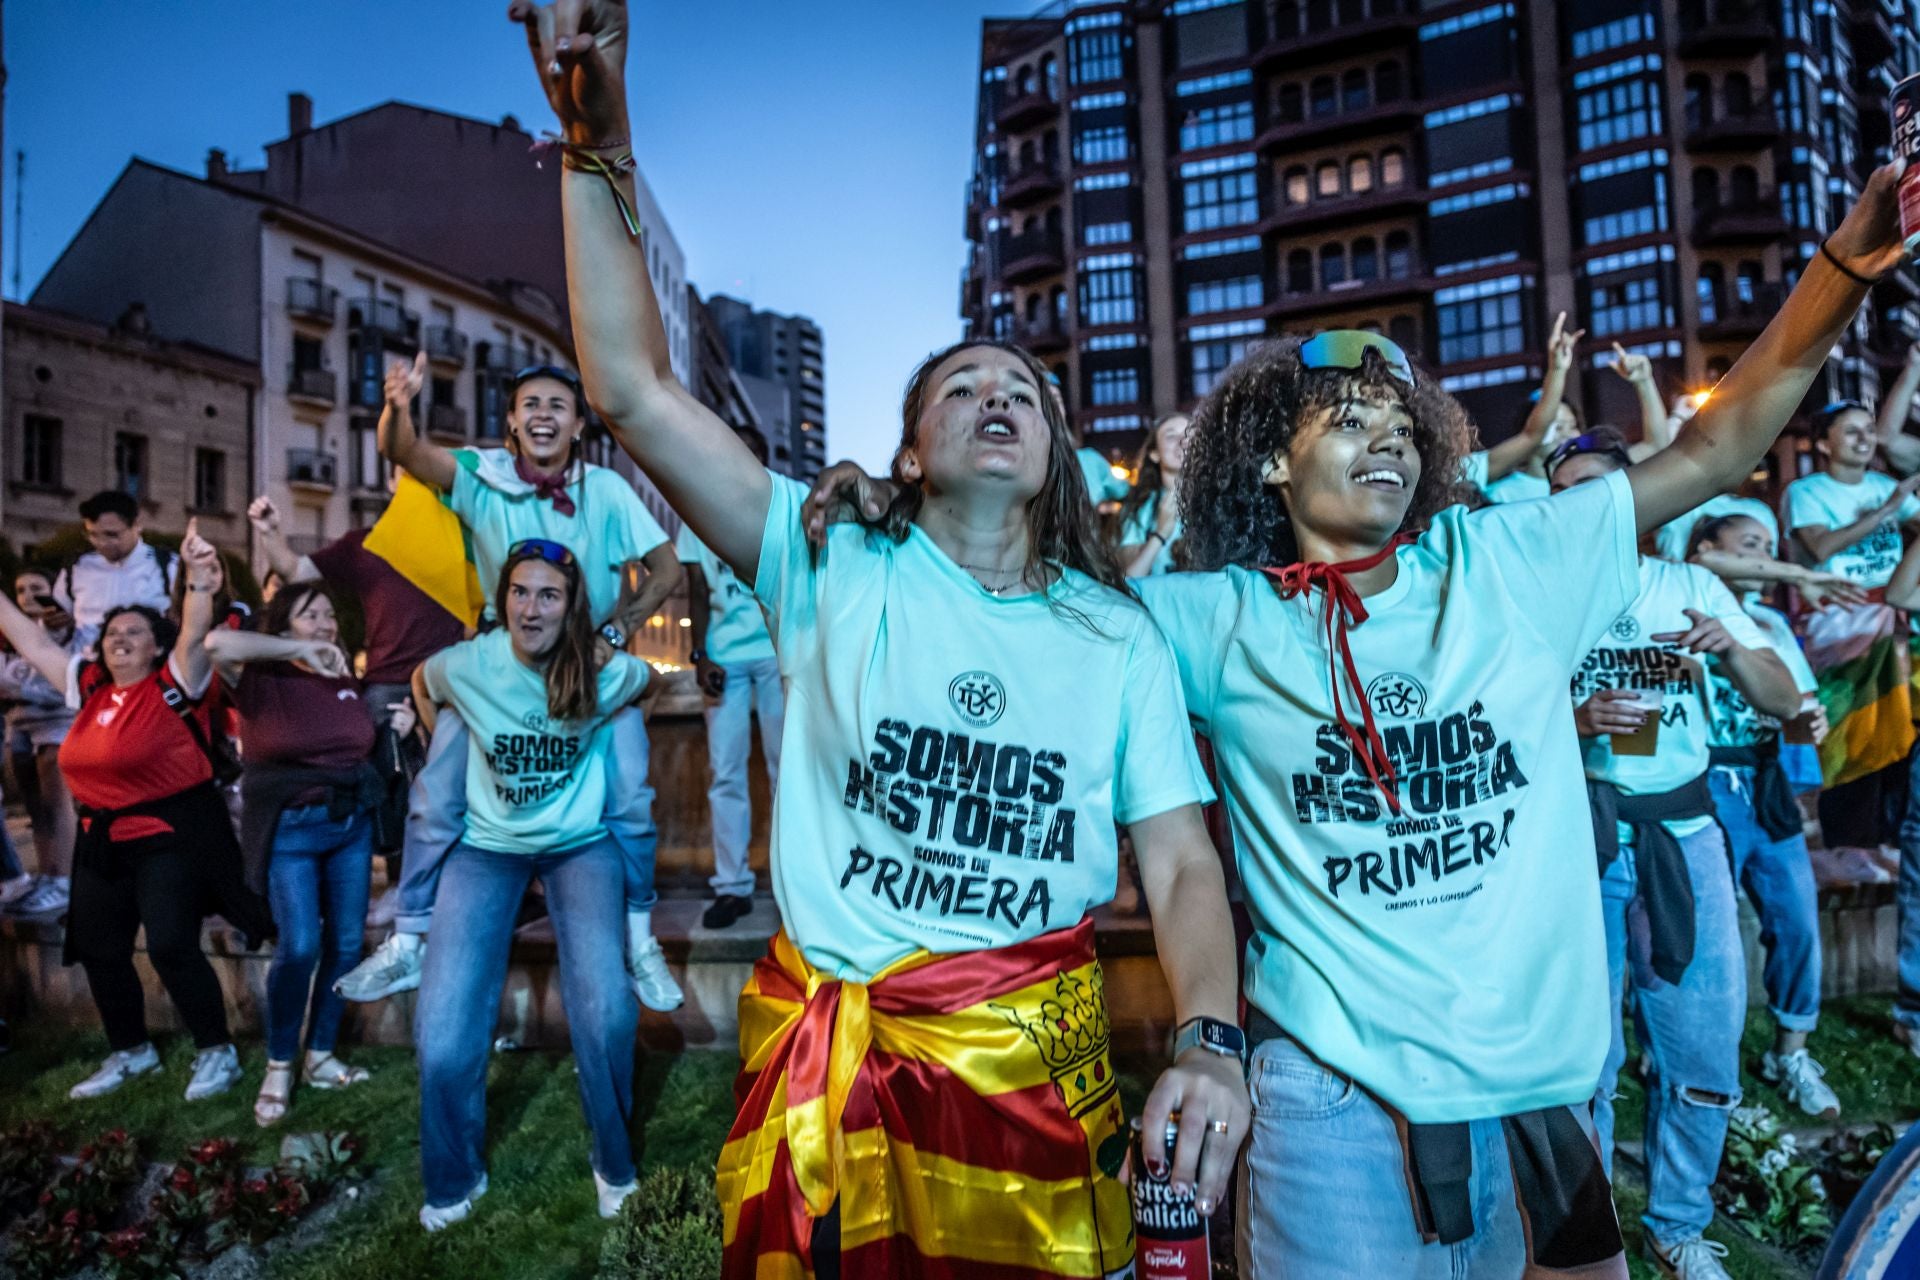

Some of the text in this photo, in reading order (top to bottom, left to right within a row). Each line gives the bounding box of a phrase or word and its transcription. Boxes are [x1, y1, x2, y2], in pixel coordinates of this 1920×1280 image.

[1581, 644, 1681, 671] SOMOS
[493, 733, 580, 757] SOMOS
[869, 717, 1067, 804] SOMOS
[1315, 699, 1497, 777] SOMOS
[844, 756, 1076, 863] HISTORIA
[1292, 740, 1529, 825] HISTORIA
[913, 845, 991, 873] SOMOS DE
[1385, 814, 1464, 838] SOMOS DE
[840, 844, 1054, 929] PRIMERA
